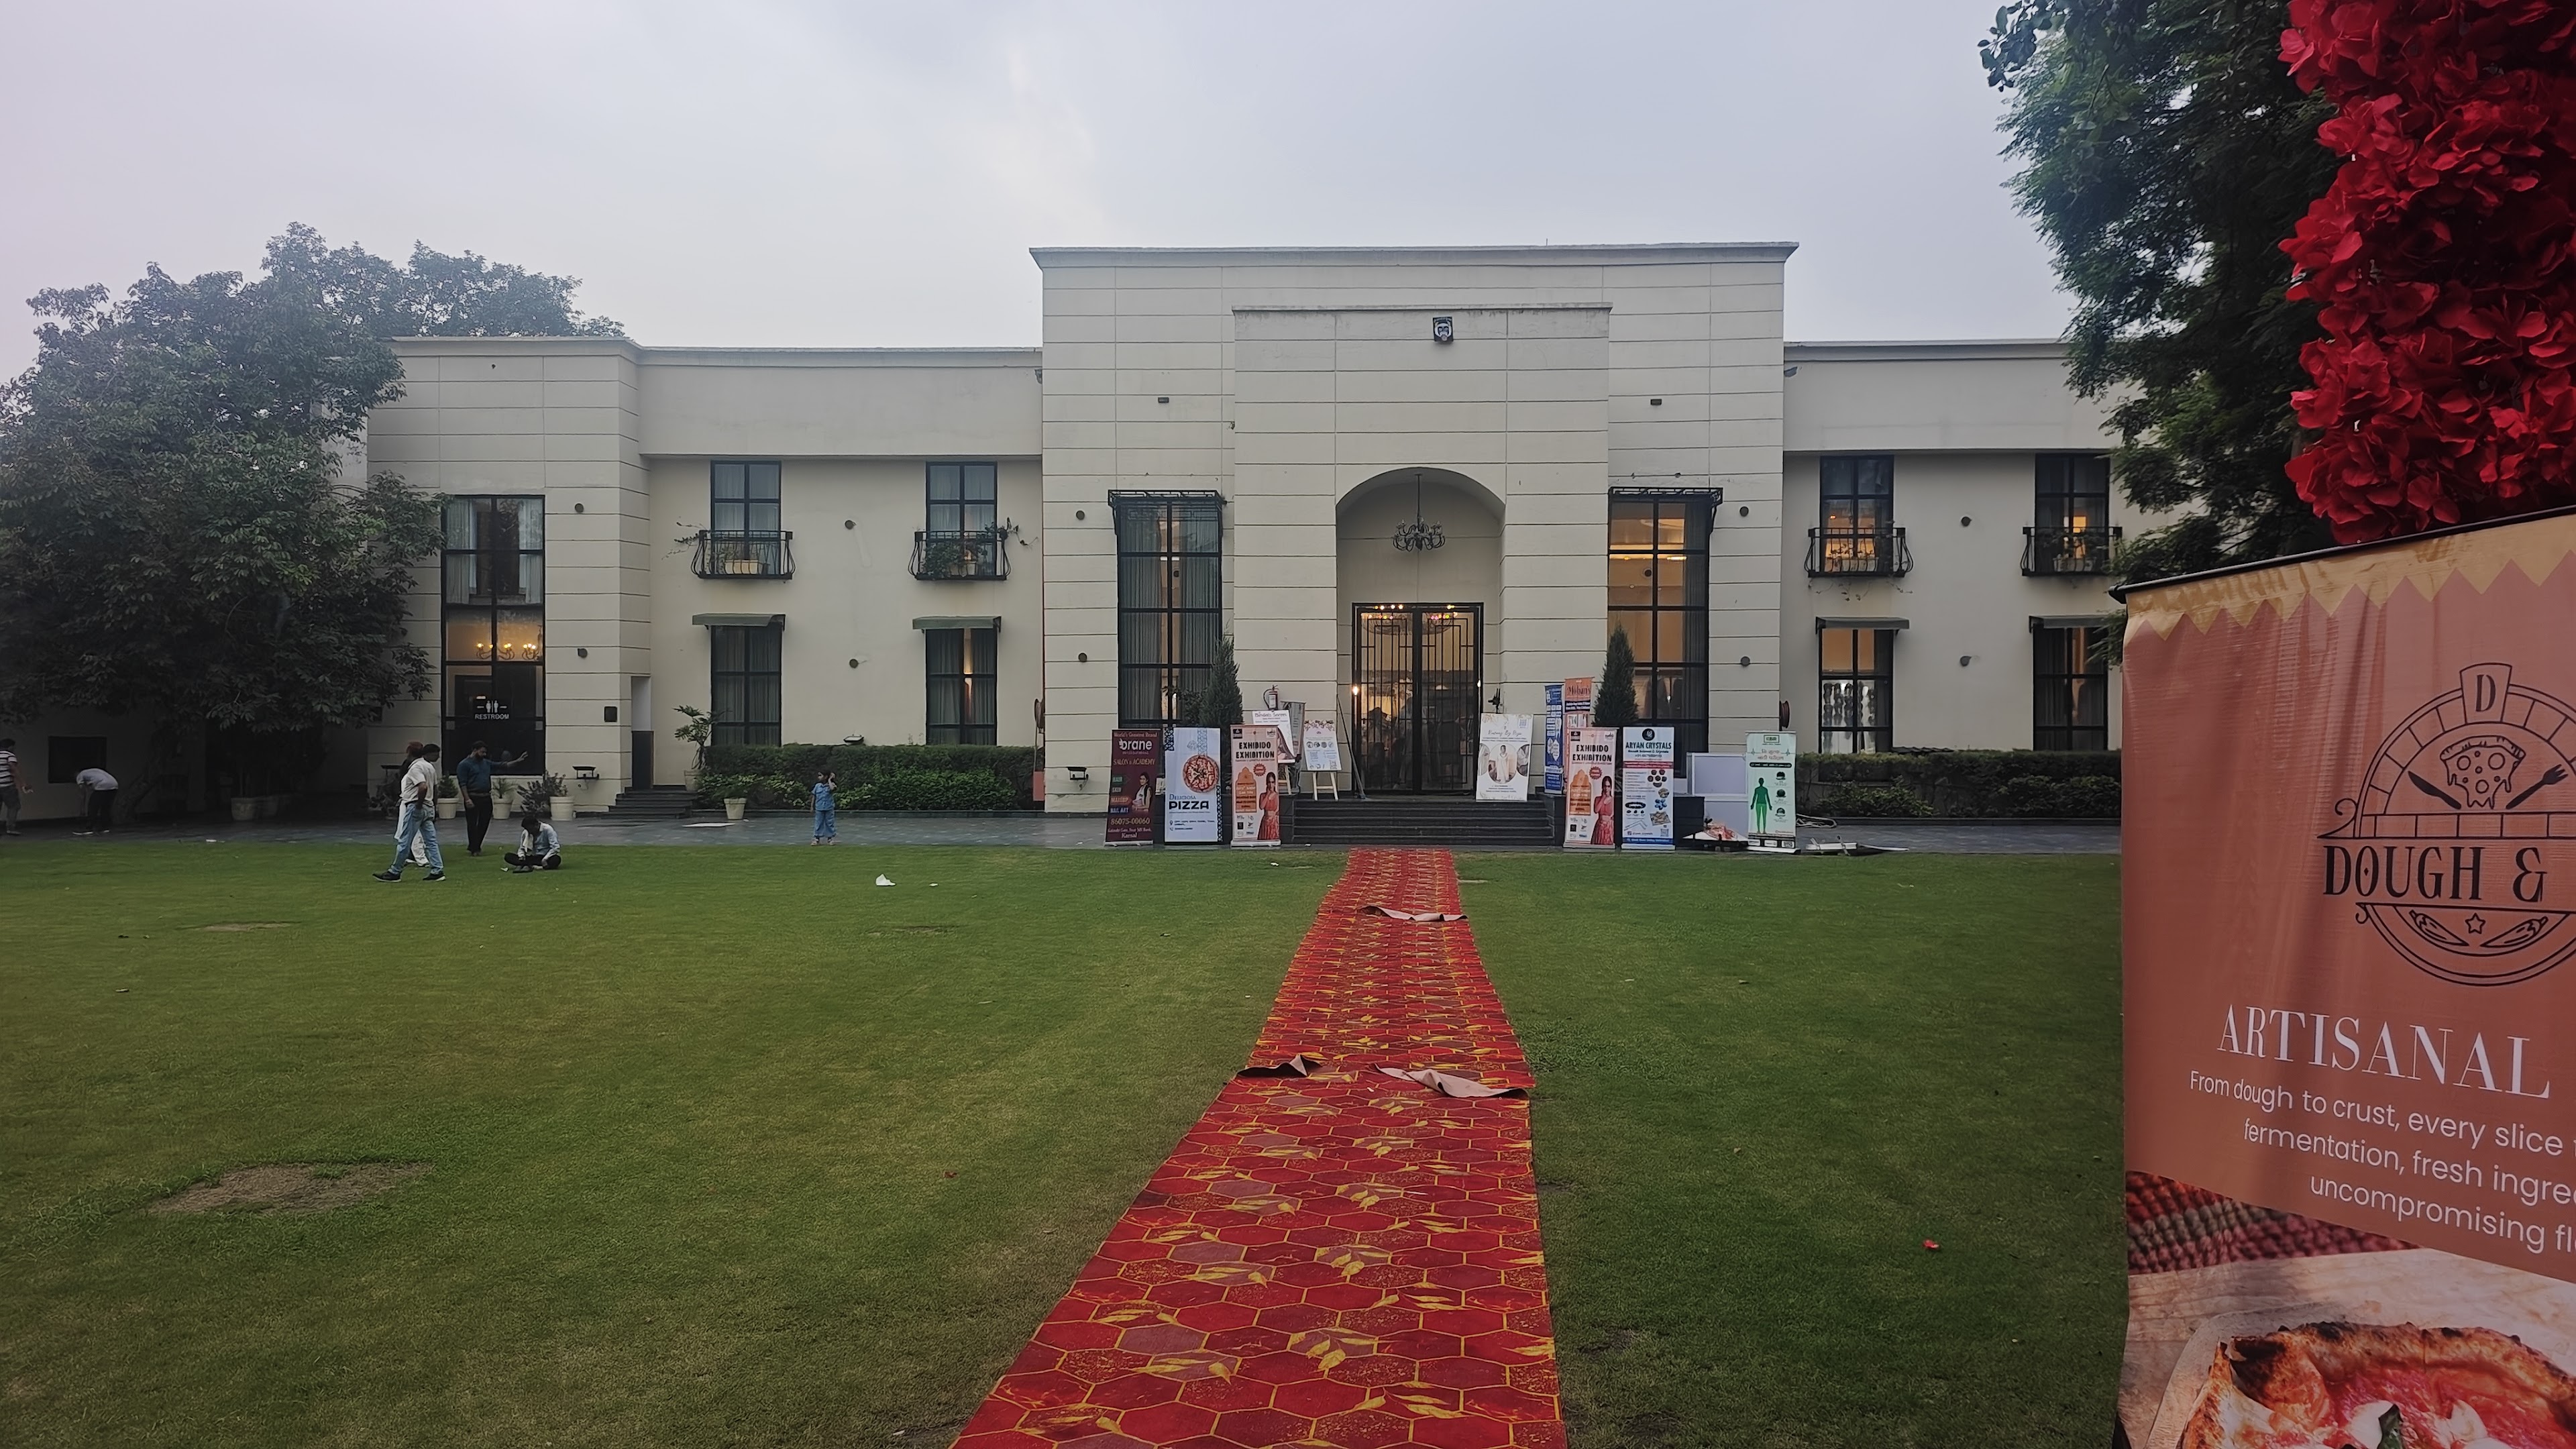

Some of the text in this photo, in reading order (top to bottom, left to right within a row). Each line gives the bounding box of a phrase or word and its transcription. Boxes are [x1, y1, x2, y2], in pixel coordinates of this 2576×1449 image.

[2475, 674, 2497, 712] D
[1239, 741, 1271, 749] EXHIBIDO
[1169, 801, 1209, 810] PIZZA
[2322, 845, 2548, 902] DOUGH &
[2216, 1004, 2551, 1099] ARTISANAL
[2190, 1070, 2230, 1097] From
[2233, 1077, 2293, 1114] dough
[2302, 1089, 2327, 1114] to
[2333, 1095, 2400, 1132] crust,
[2408, 1112, 2486, 1150] every
[2495, 1123, 2563, 1156] slice
[2244, 1118, 2576, 1206] fermentation, fresh ingre
[2310, 1175, 2576, 1253] uncompromising fl
